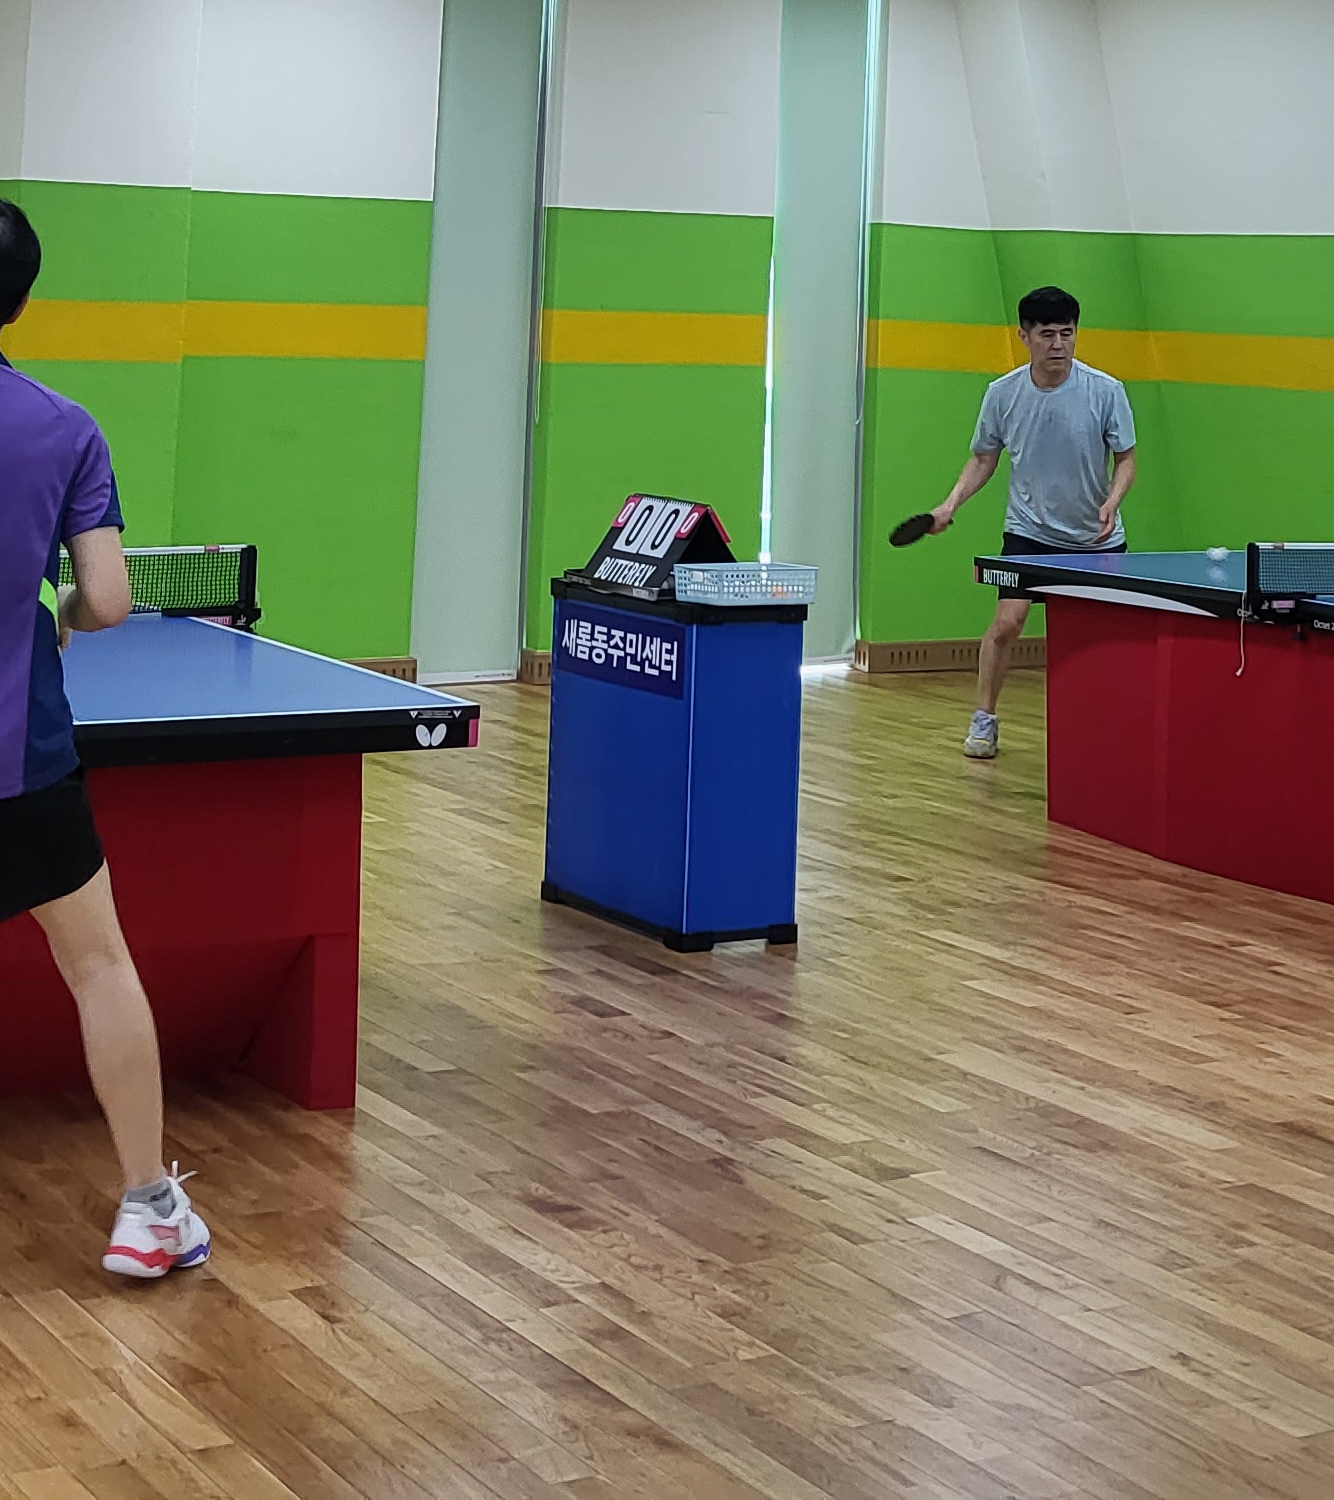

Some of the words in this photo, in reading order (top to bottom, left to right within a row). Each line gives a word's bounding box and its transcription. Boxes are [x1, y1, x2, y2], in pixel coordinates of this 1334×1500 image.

[593, 556, 658, 588] BUTTERFLY
[983, 568, 1020, 589] BUTTERFLY
[561, 618, 678, 682] 새롬동주민센터
